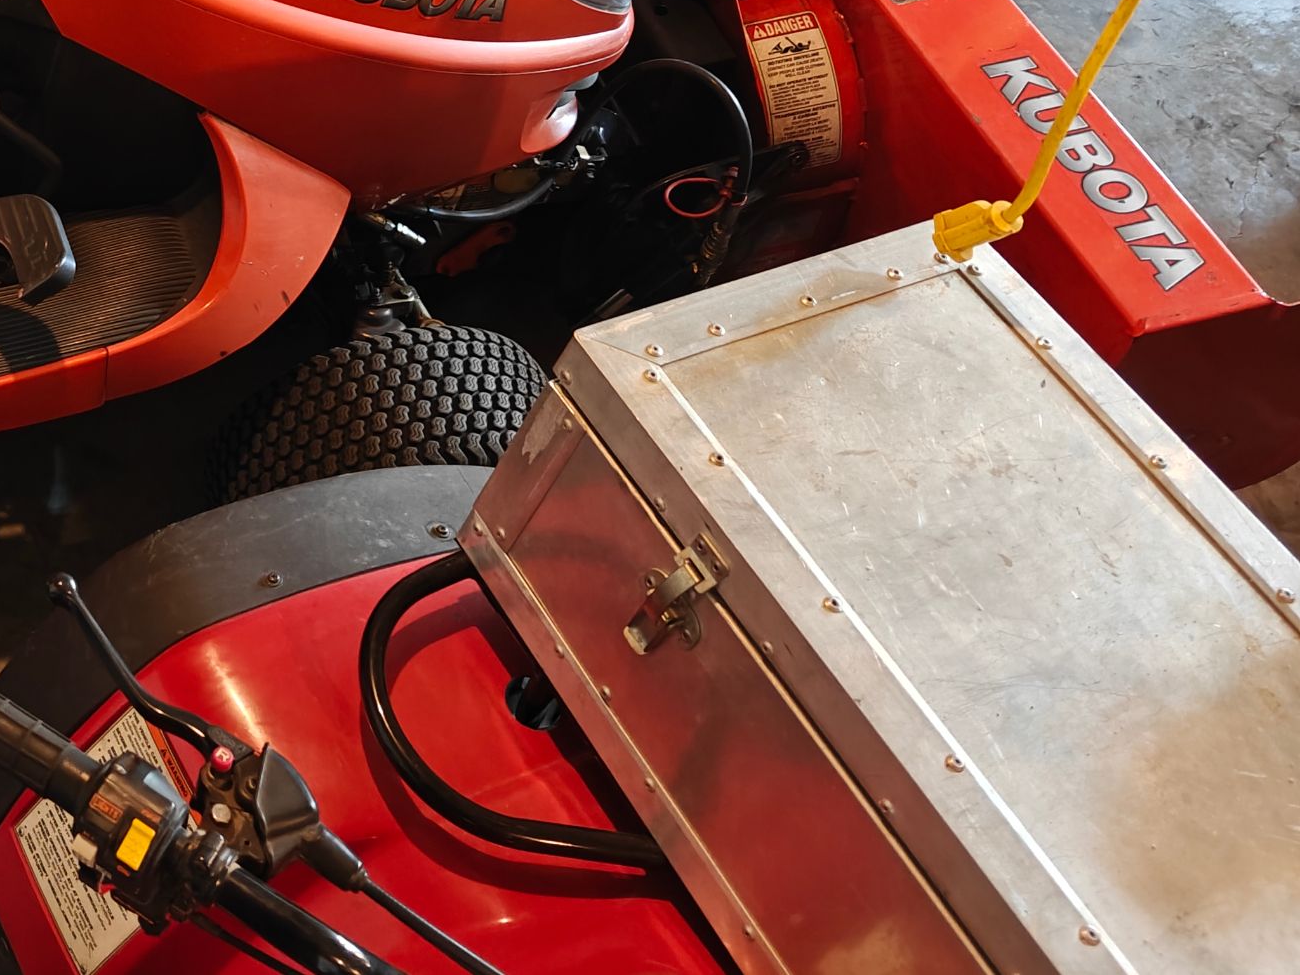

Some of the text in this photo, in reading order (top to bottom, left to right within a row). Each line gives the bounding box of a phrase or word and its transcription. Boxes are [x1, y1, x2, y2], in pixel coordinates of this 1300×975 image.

[765, 15, 814, 37] DANGER
[980, 56, 1205, 291] KUBOTA
[215, 749, 230, 763] R
[166, 758, 188, 797] WARNING
